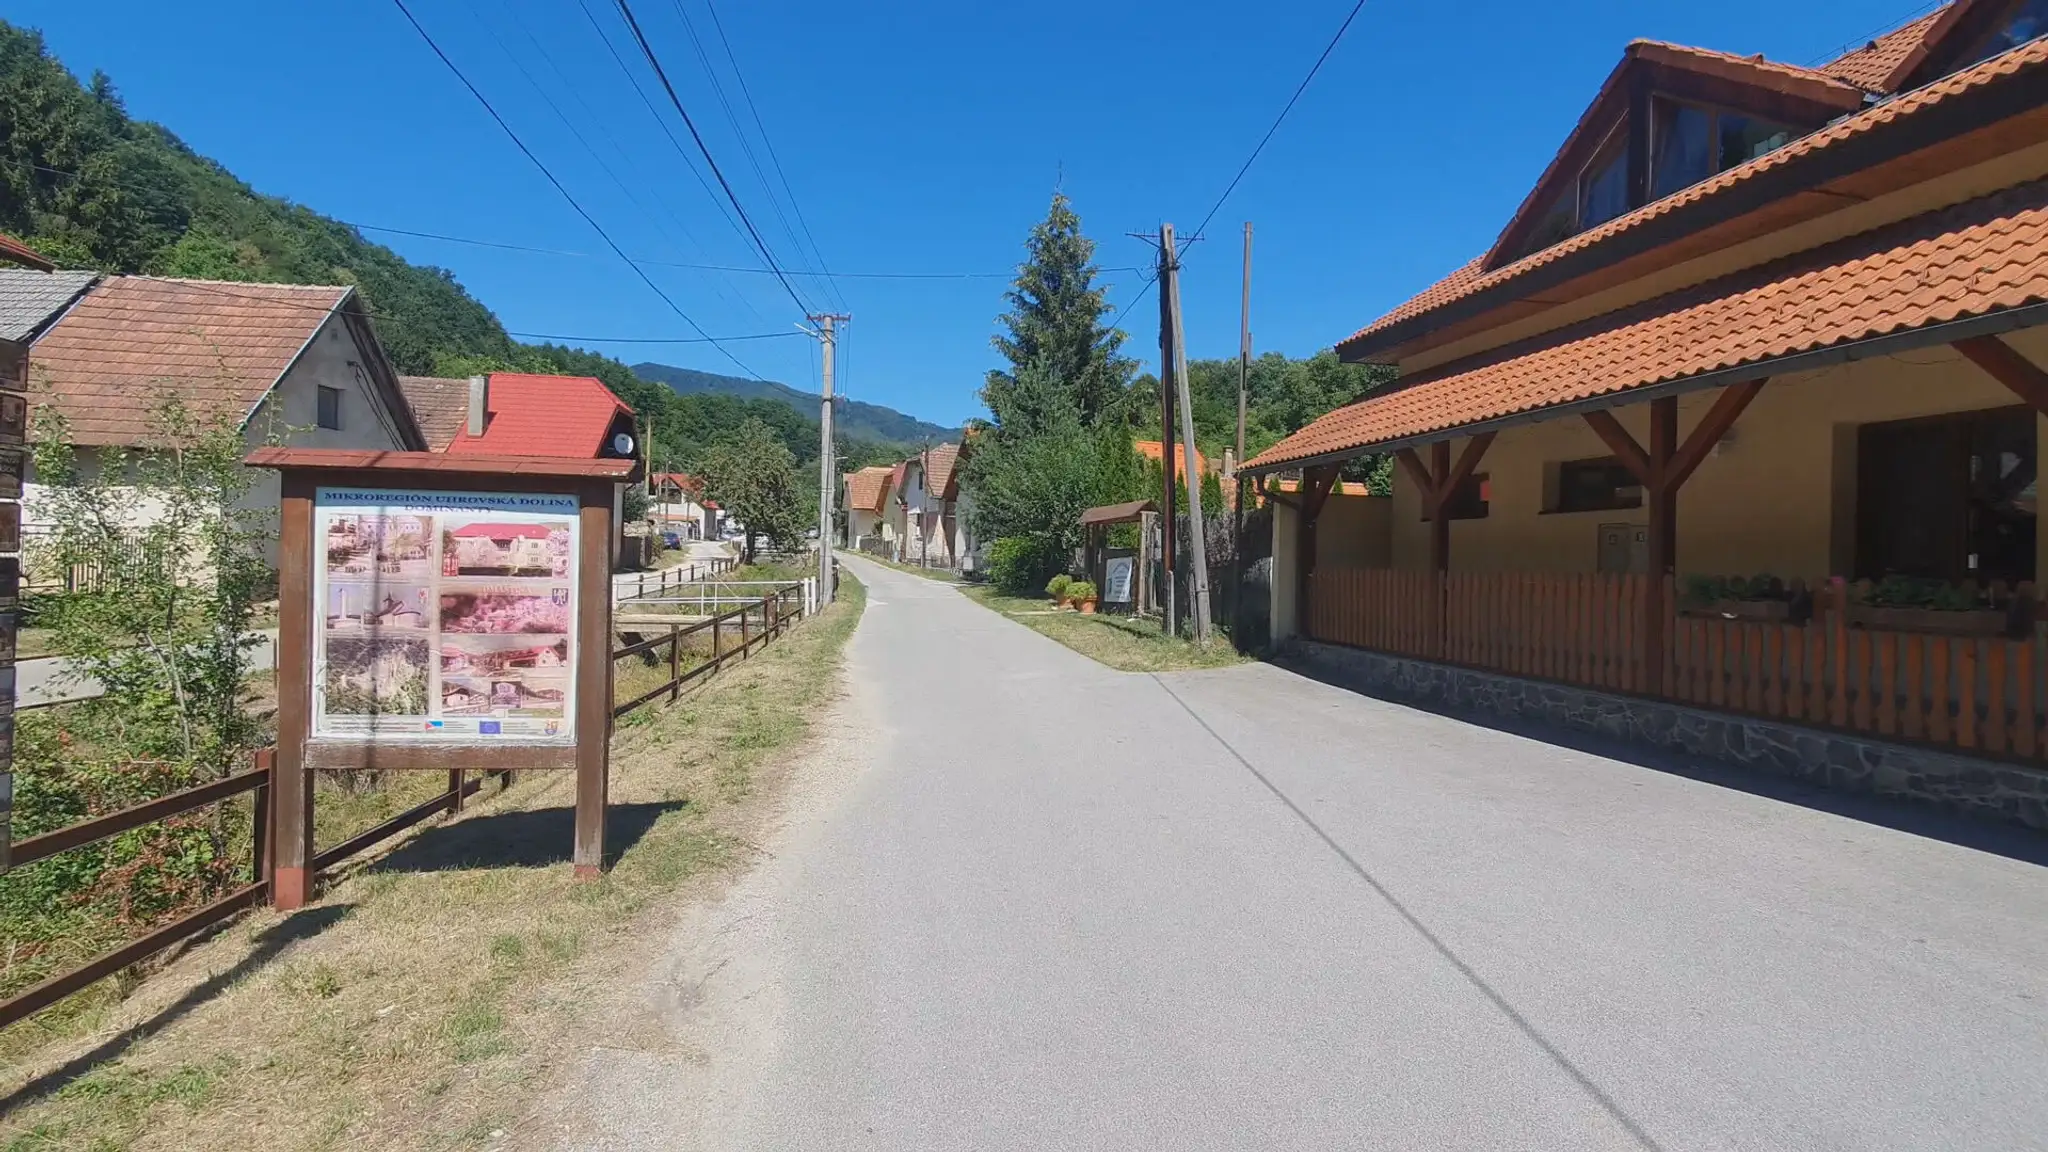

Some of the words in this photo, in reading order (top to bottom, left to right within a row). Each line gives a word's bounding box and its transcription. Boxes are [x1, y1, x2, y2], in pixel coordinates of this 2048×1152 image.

[324, 492, 432, 503] MIKROREGIÓN
[436, 495, 517, 505] UHROVSKÁ
[519, 498, 574, 507] DOLINA
[405, 504, 492, 513] DOMINANTY
